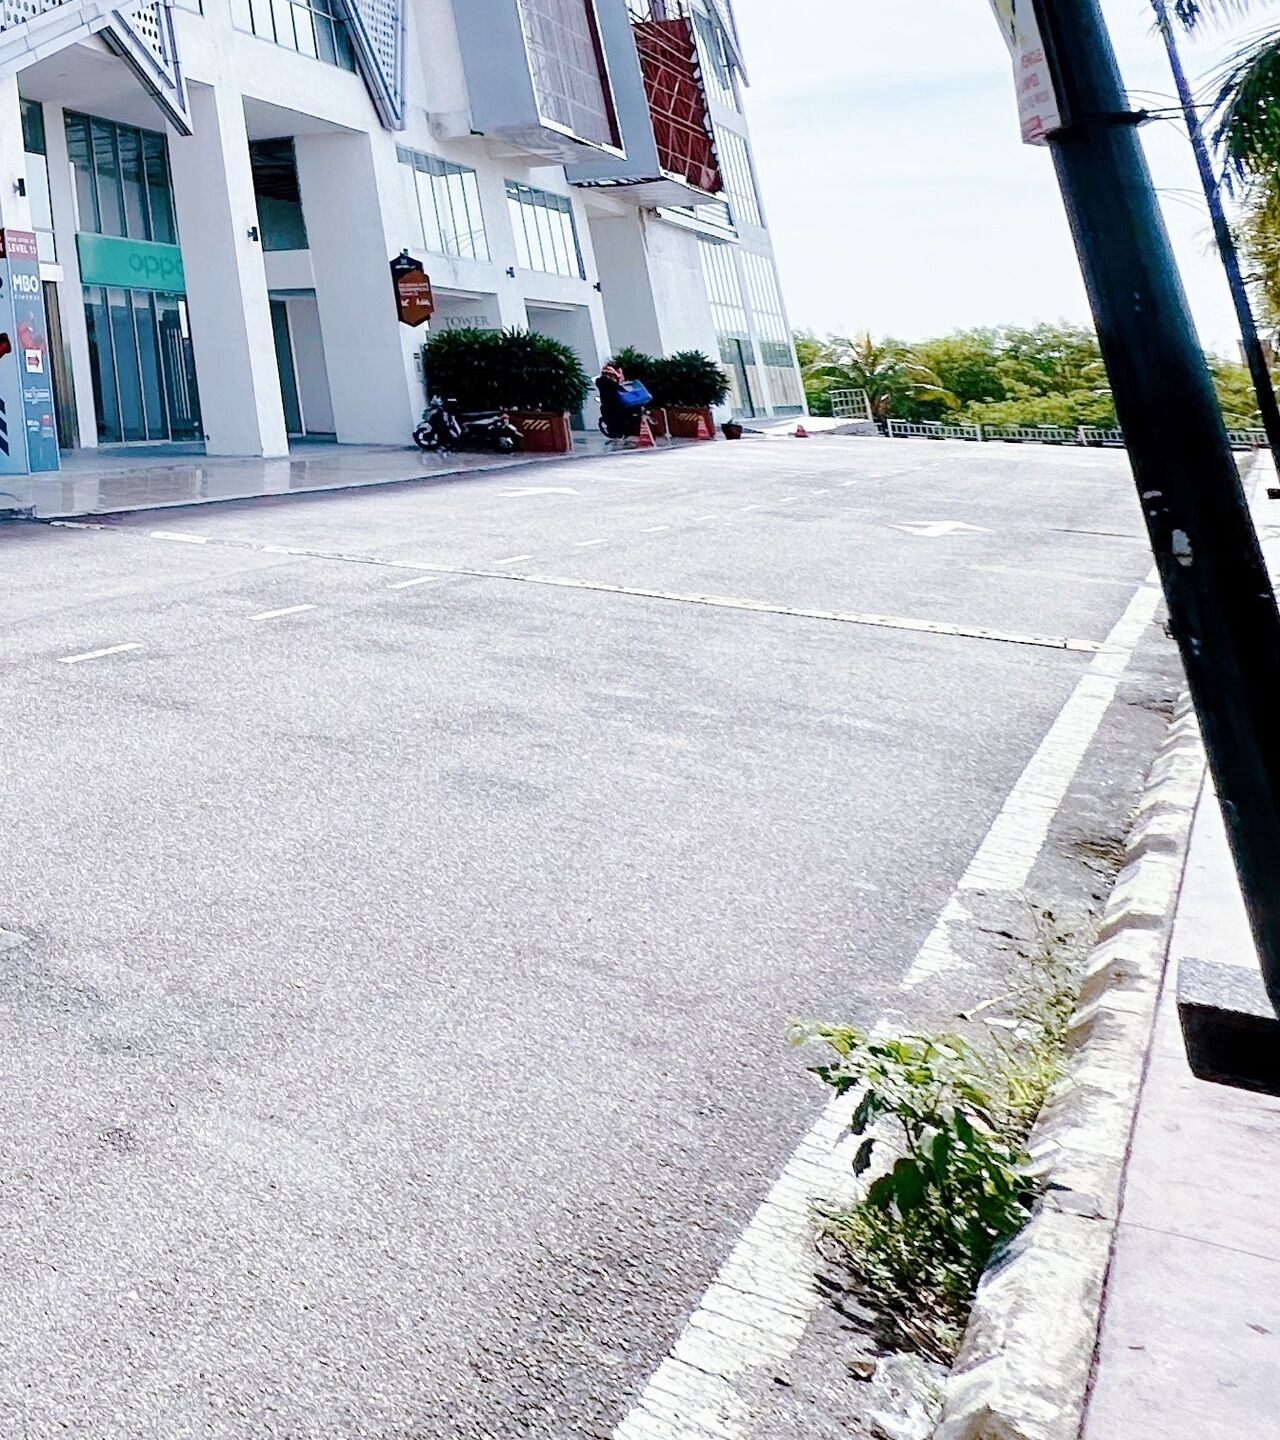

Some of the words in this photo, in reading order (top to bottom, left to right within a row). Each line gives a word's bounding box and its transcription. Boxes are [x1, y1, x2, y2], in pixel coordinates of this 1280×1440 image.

[8, 243, 28, 254] LEVEL
[12, 274, 39, 292] MBO
[442, 315, 489, 327] TOWER
